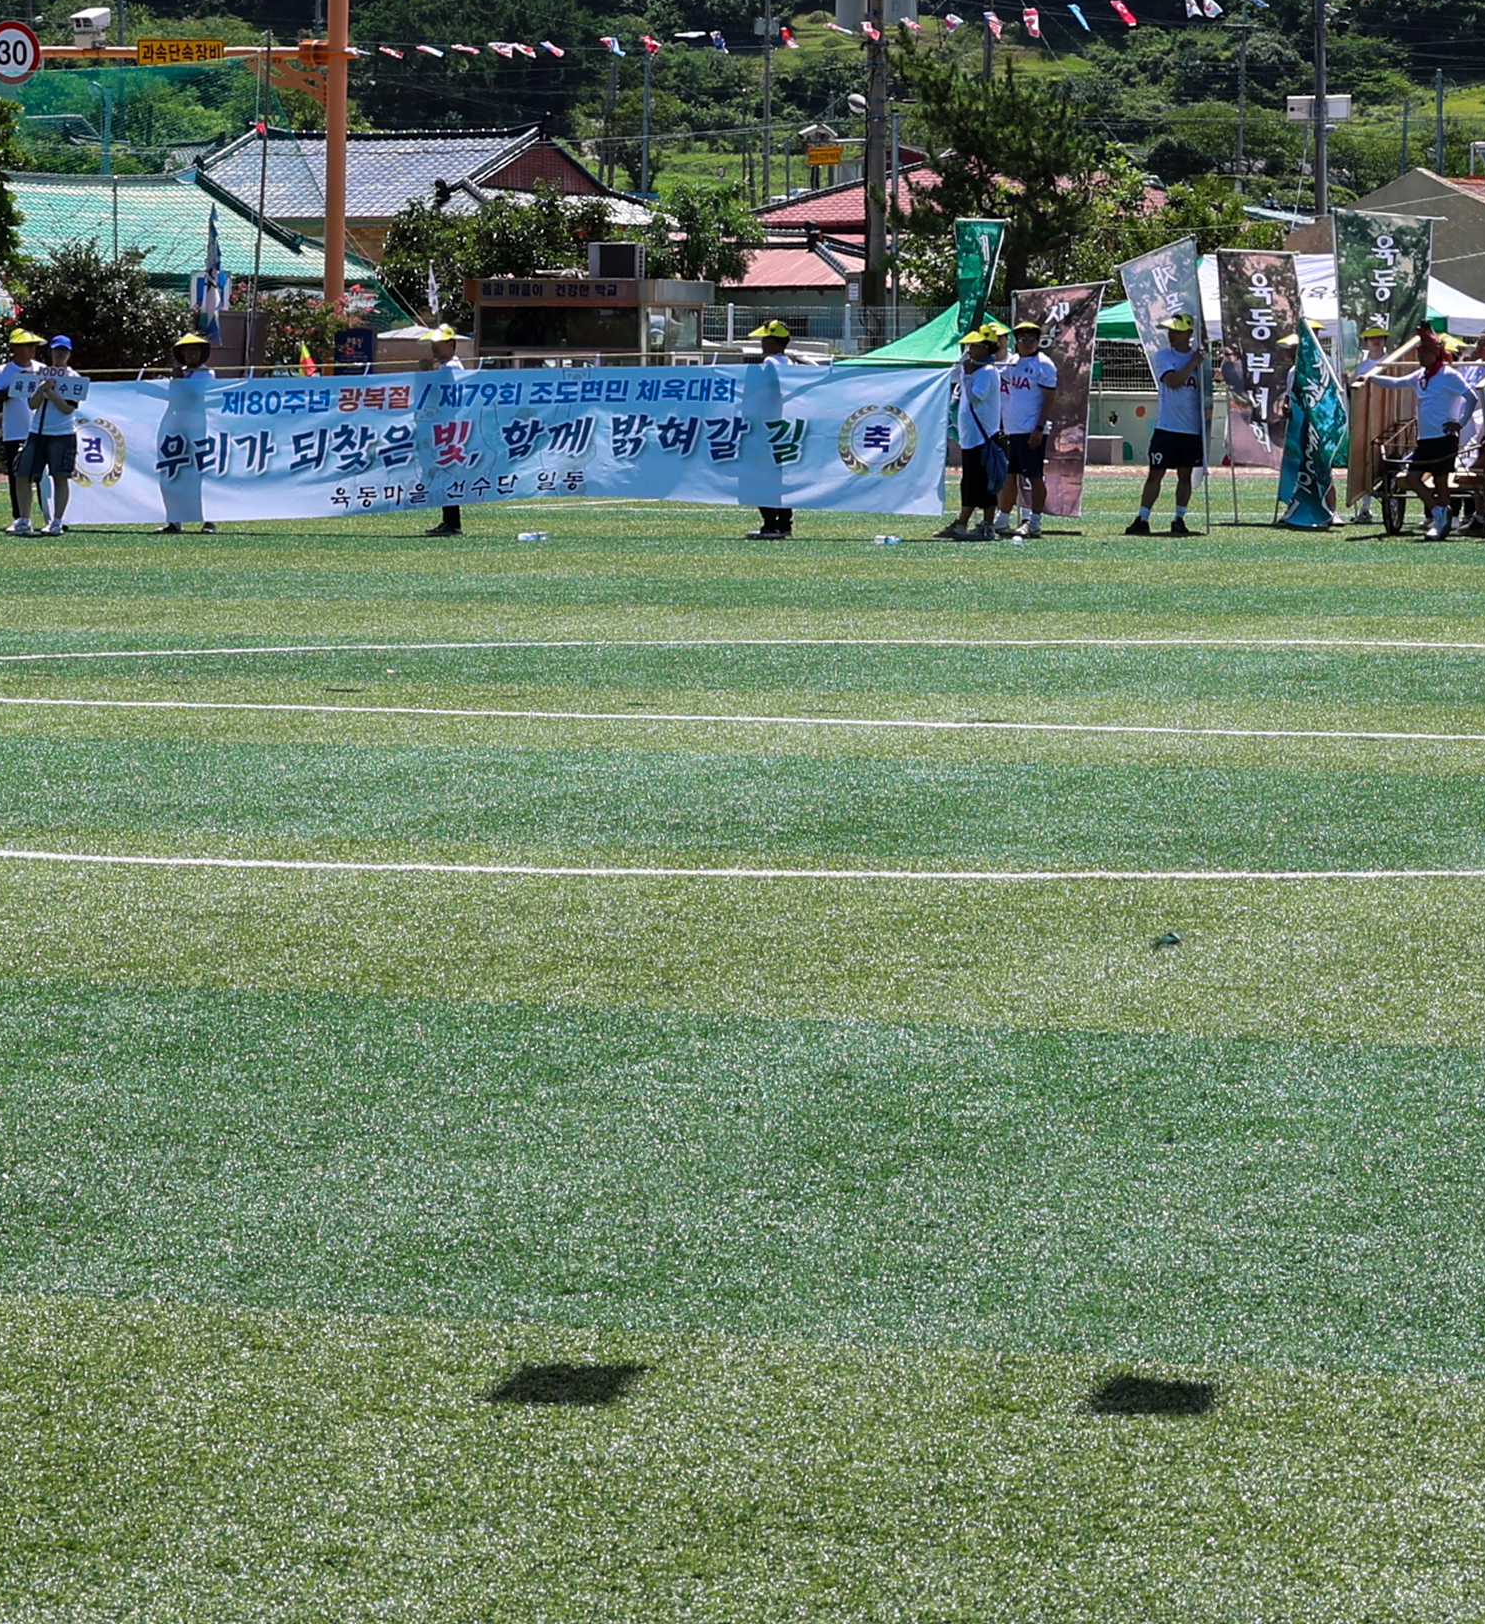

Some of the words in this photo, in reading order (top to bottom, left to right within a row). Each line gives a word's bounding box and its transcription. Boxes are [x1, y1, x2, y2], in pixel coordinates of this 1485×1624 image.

[141, 42, 222, 63] 과속단속장비
[1371, 235, 1400, 302] 육동
[555, 284, 590, 297] 건강한
[1246, 272, 1278, 341] 육동
[37, 367, 65, 377] JODO
[221, 388, 331, 416] 제80주년
[338, 386, 411, 412] 광복절
[439, 382, 522, 408] 제79회
[528, 380, 629, 405] 조도면민
[635, 378, 736, 403] 체육대회
[1245, 351, 1275, 453] 부녀회
[81, 437, 105, 463] 경
[157, 430, 275, 478] 우리가
[290, 424, 414, 471] 되찾은
[433, 421, 481, 466] 빛,
[502, 416, 593, 460] 함께
[611, 414, 747, 462] 밝혀갈
[766, 419, 805, 464] 길
[863, 425, 891, 453] 축
[330, 485, 429, 508] 육동마을
[446, 475, 518, 498] 선수단
[537, 471, 585, 491] 일동
